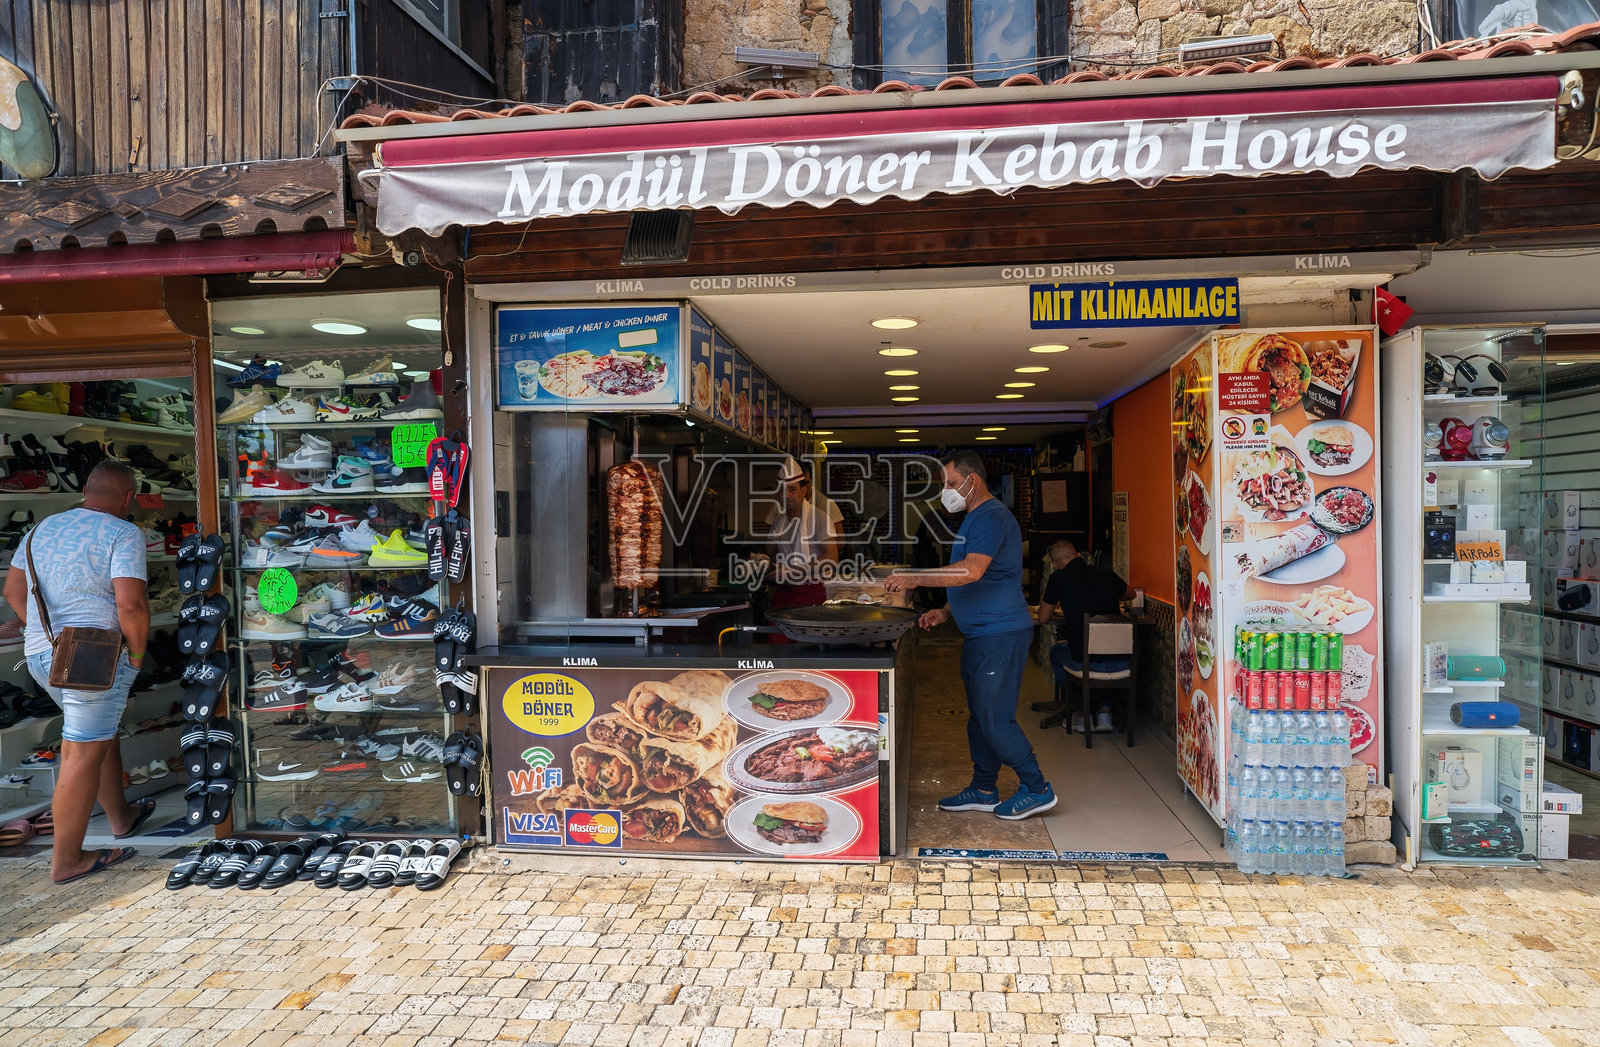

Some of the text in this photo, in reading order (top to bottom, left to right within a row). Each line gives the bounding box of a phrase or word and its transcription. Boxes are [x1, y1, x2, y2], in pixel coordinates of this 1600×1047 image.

[498, 114, 1408, 218] Modül Döner Kebab House
[1294, 252, 1351, 270] KLİMA
[1001, 265, 1047, 279] COLD
[595, 279, 645, 294] KLİMA
[690, 277, 733, 291] COLD
[1032, 283, 1076, 321] MİT
[510, 334, 518, 343] ET
[582, 322, 603, 332] MEAT
[613, 316, 643, 328] CHICKEN
[738, 658, 774, 669] KLİMA
[522, 679, 574, 695] MODÜL
[523, 700, 574, 718] DÖNER
[539, 718, 559, 726] 1999
[510, 813, 559, 832] VISA
[569, 822, 617, 834] MasterCard
